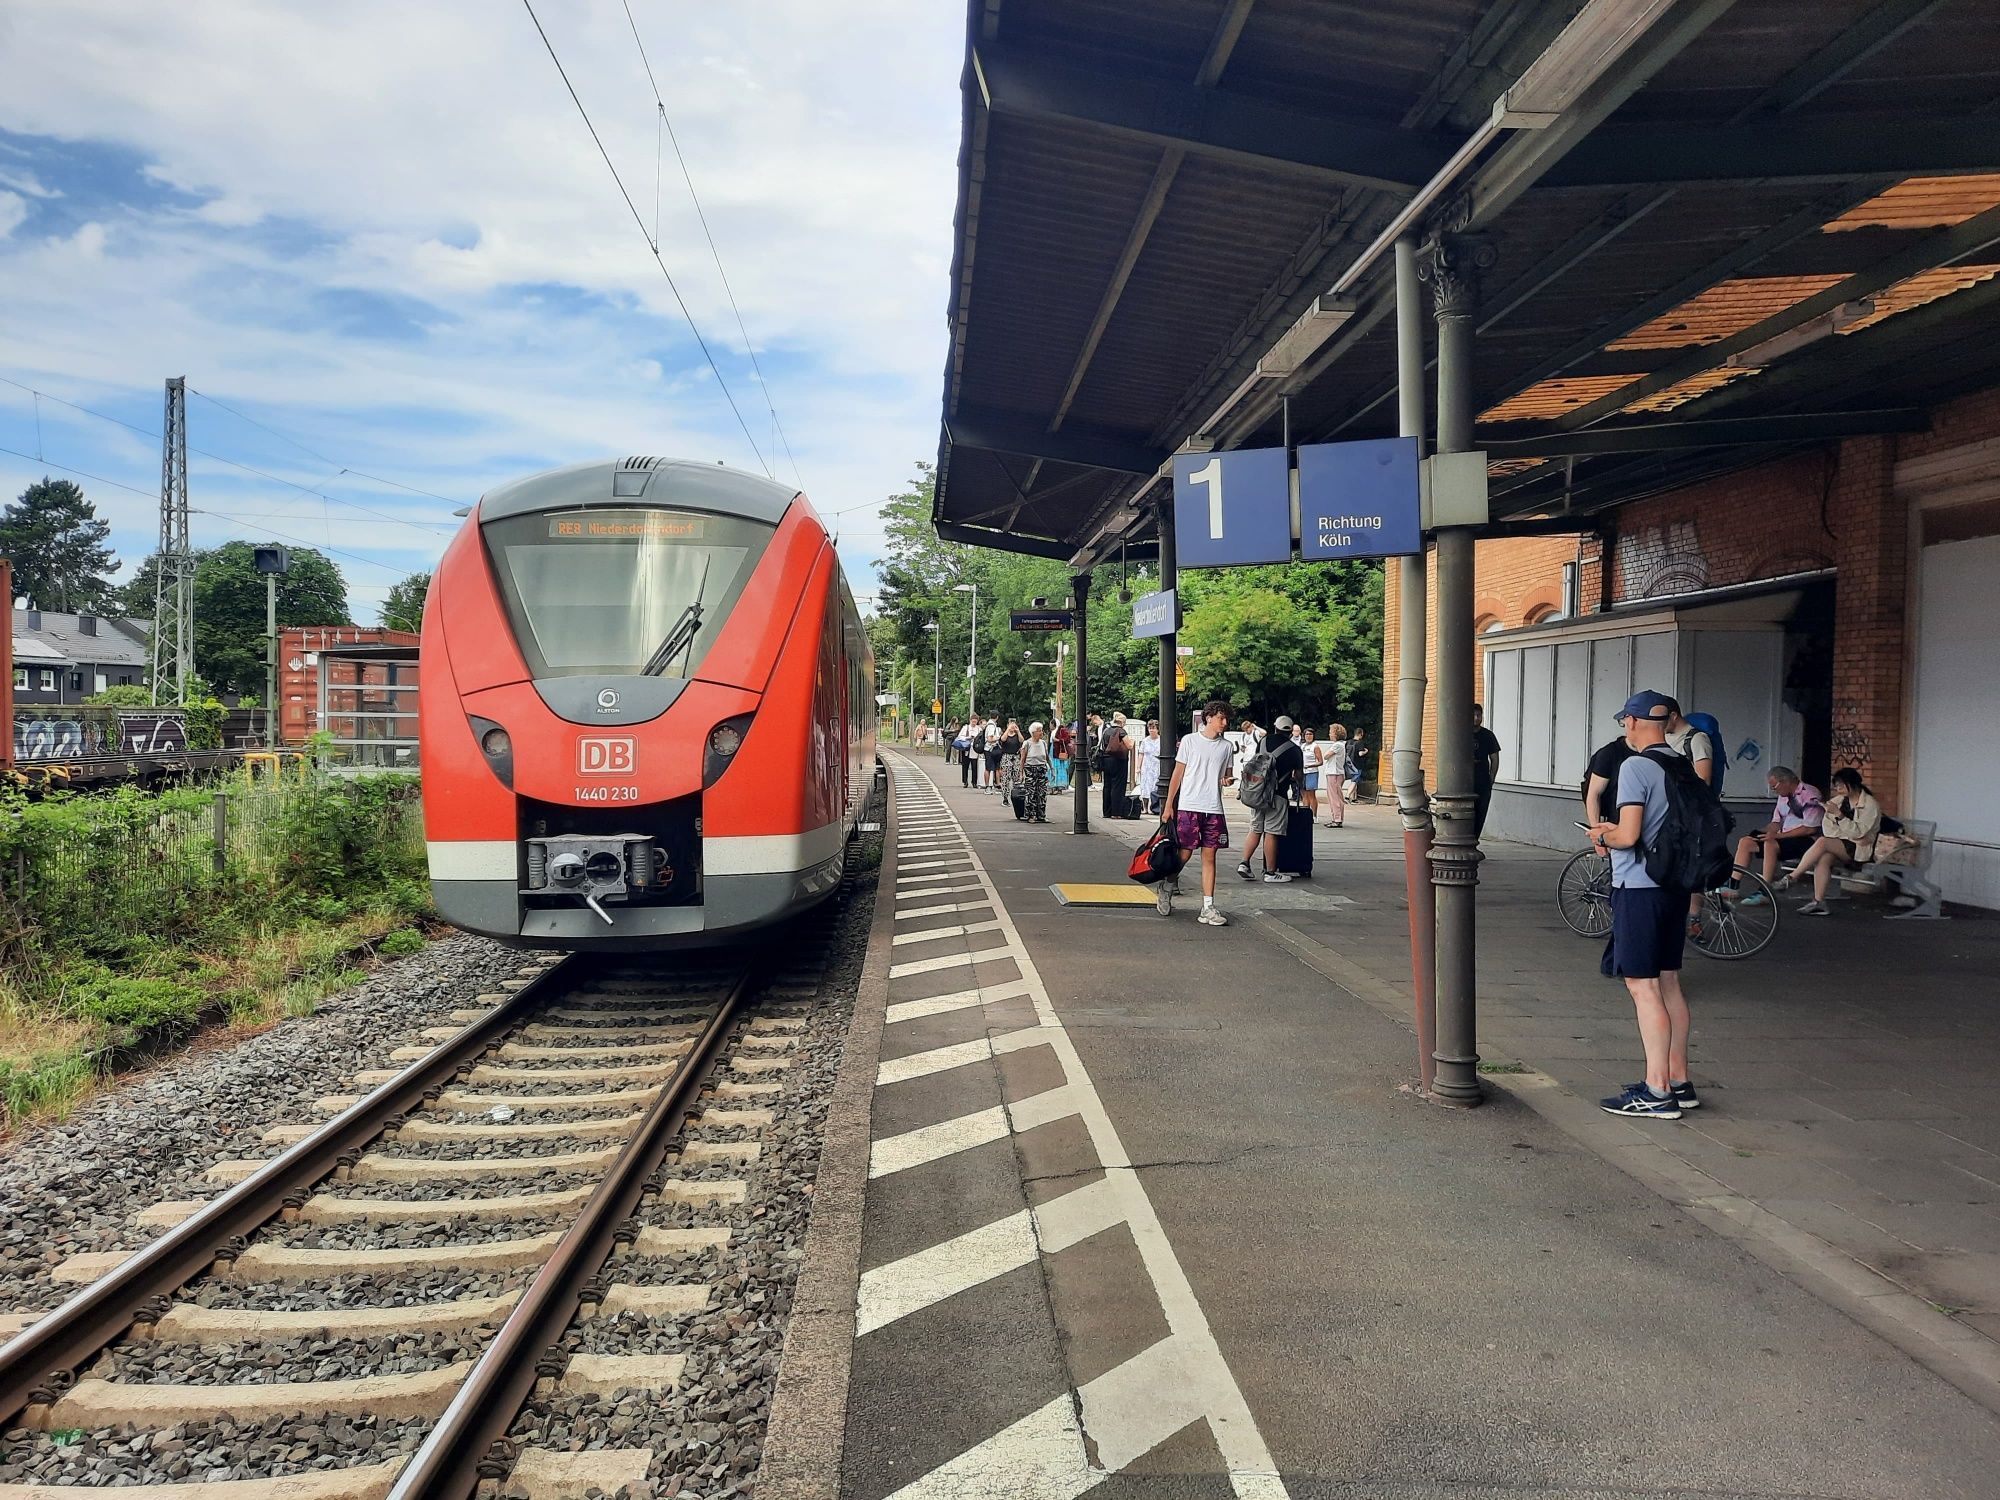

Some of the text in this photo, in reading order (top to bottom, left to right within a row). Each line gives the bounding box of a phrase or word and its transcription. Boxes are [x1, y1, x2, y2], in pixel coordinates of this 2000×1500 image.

[1189, 458, 1224, 540] 1
[558, 521, 582, 535] RE8
[1318, 515, 1382, 530] Richtung
[1319, 533, 1351, 548] Köln
[583, 740, 631, 771] DB
[574, 786, 638, 801] 1440 230
